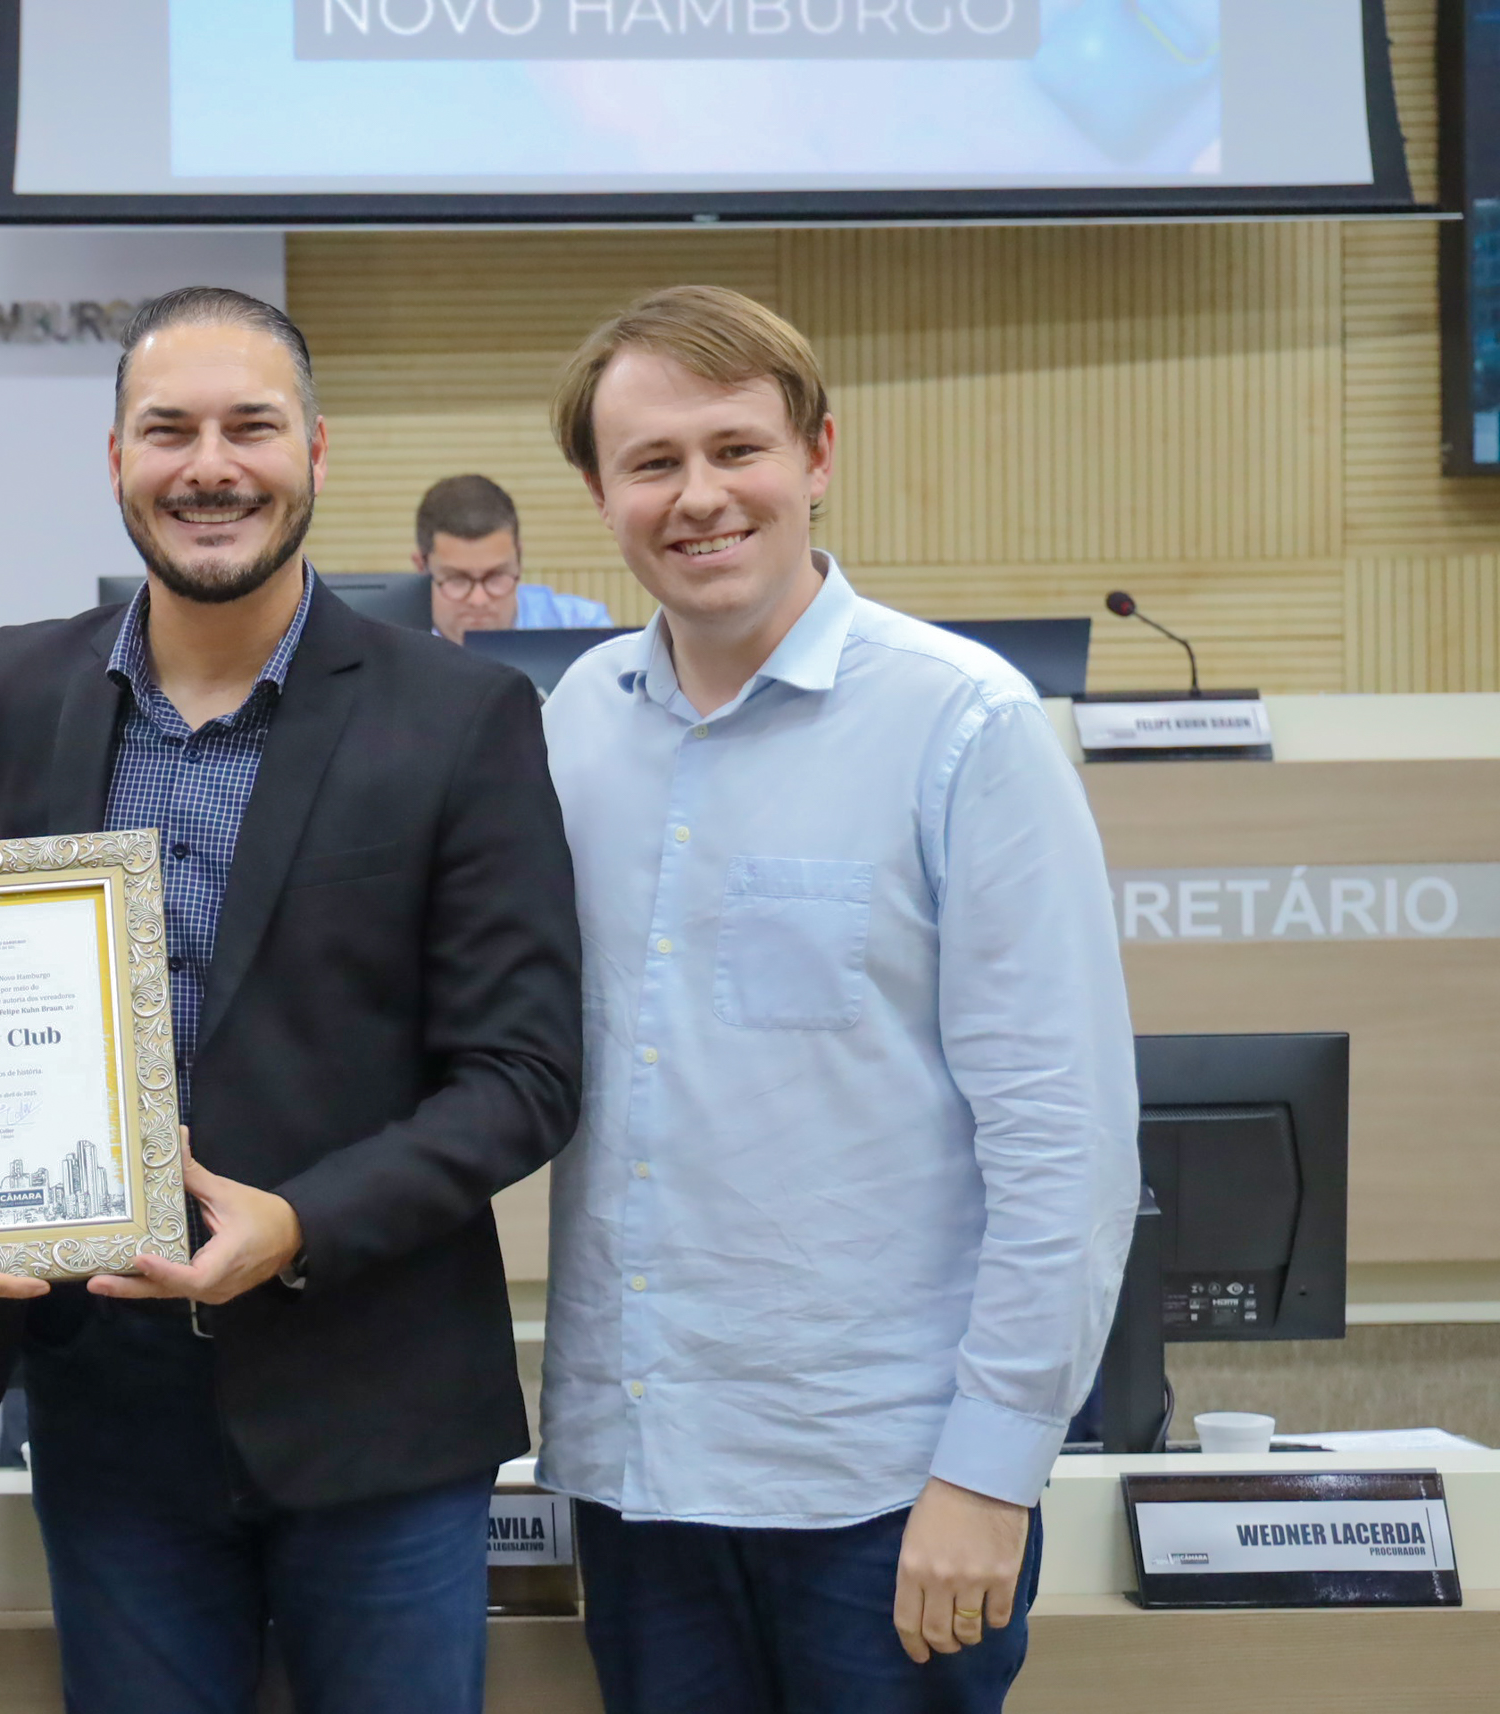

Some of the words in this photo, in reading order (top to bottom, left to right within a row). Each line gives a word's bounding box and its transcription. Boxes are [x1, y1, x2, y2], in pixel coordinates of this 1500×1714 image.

[323, 0, 542, 36] NOVO
[569, 0, 1015, 35] HAMBURGO
[1109, 865, 1459, 938] RETÁRIO
[16, 971, 51, 982] Hamburgo
[1, 986, 12, 995] por
[13, 985, 28, 993] meio
[2, 996, 26, 1005] autoria
[39, 992, 76, 1002] vereadores
[0, 1008, 20, 1017] Felipe
[21, 1007, 40, 1015] Kuhn
[7, 1026, 62, 1048] Club
[7, 1069, 16, 1077] de
[0, 1192, 43, 1202] CÂMARA
[1236, 1523, 1328, 1547] WEDNER
[1330, 1521, 1426, 1545] LACERDA
[493, 1541, 545, 1552] LEGISLATIVO
[1369, 1546, 1426, 1557] PROCURADOR
